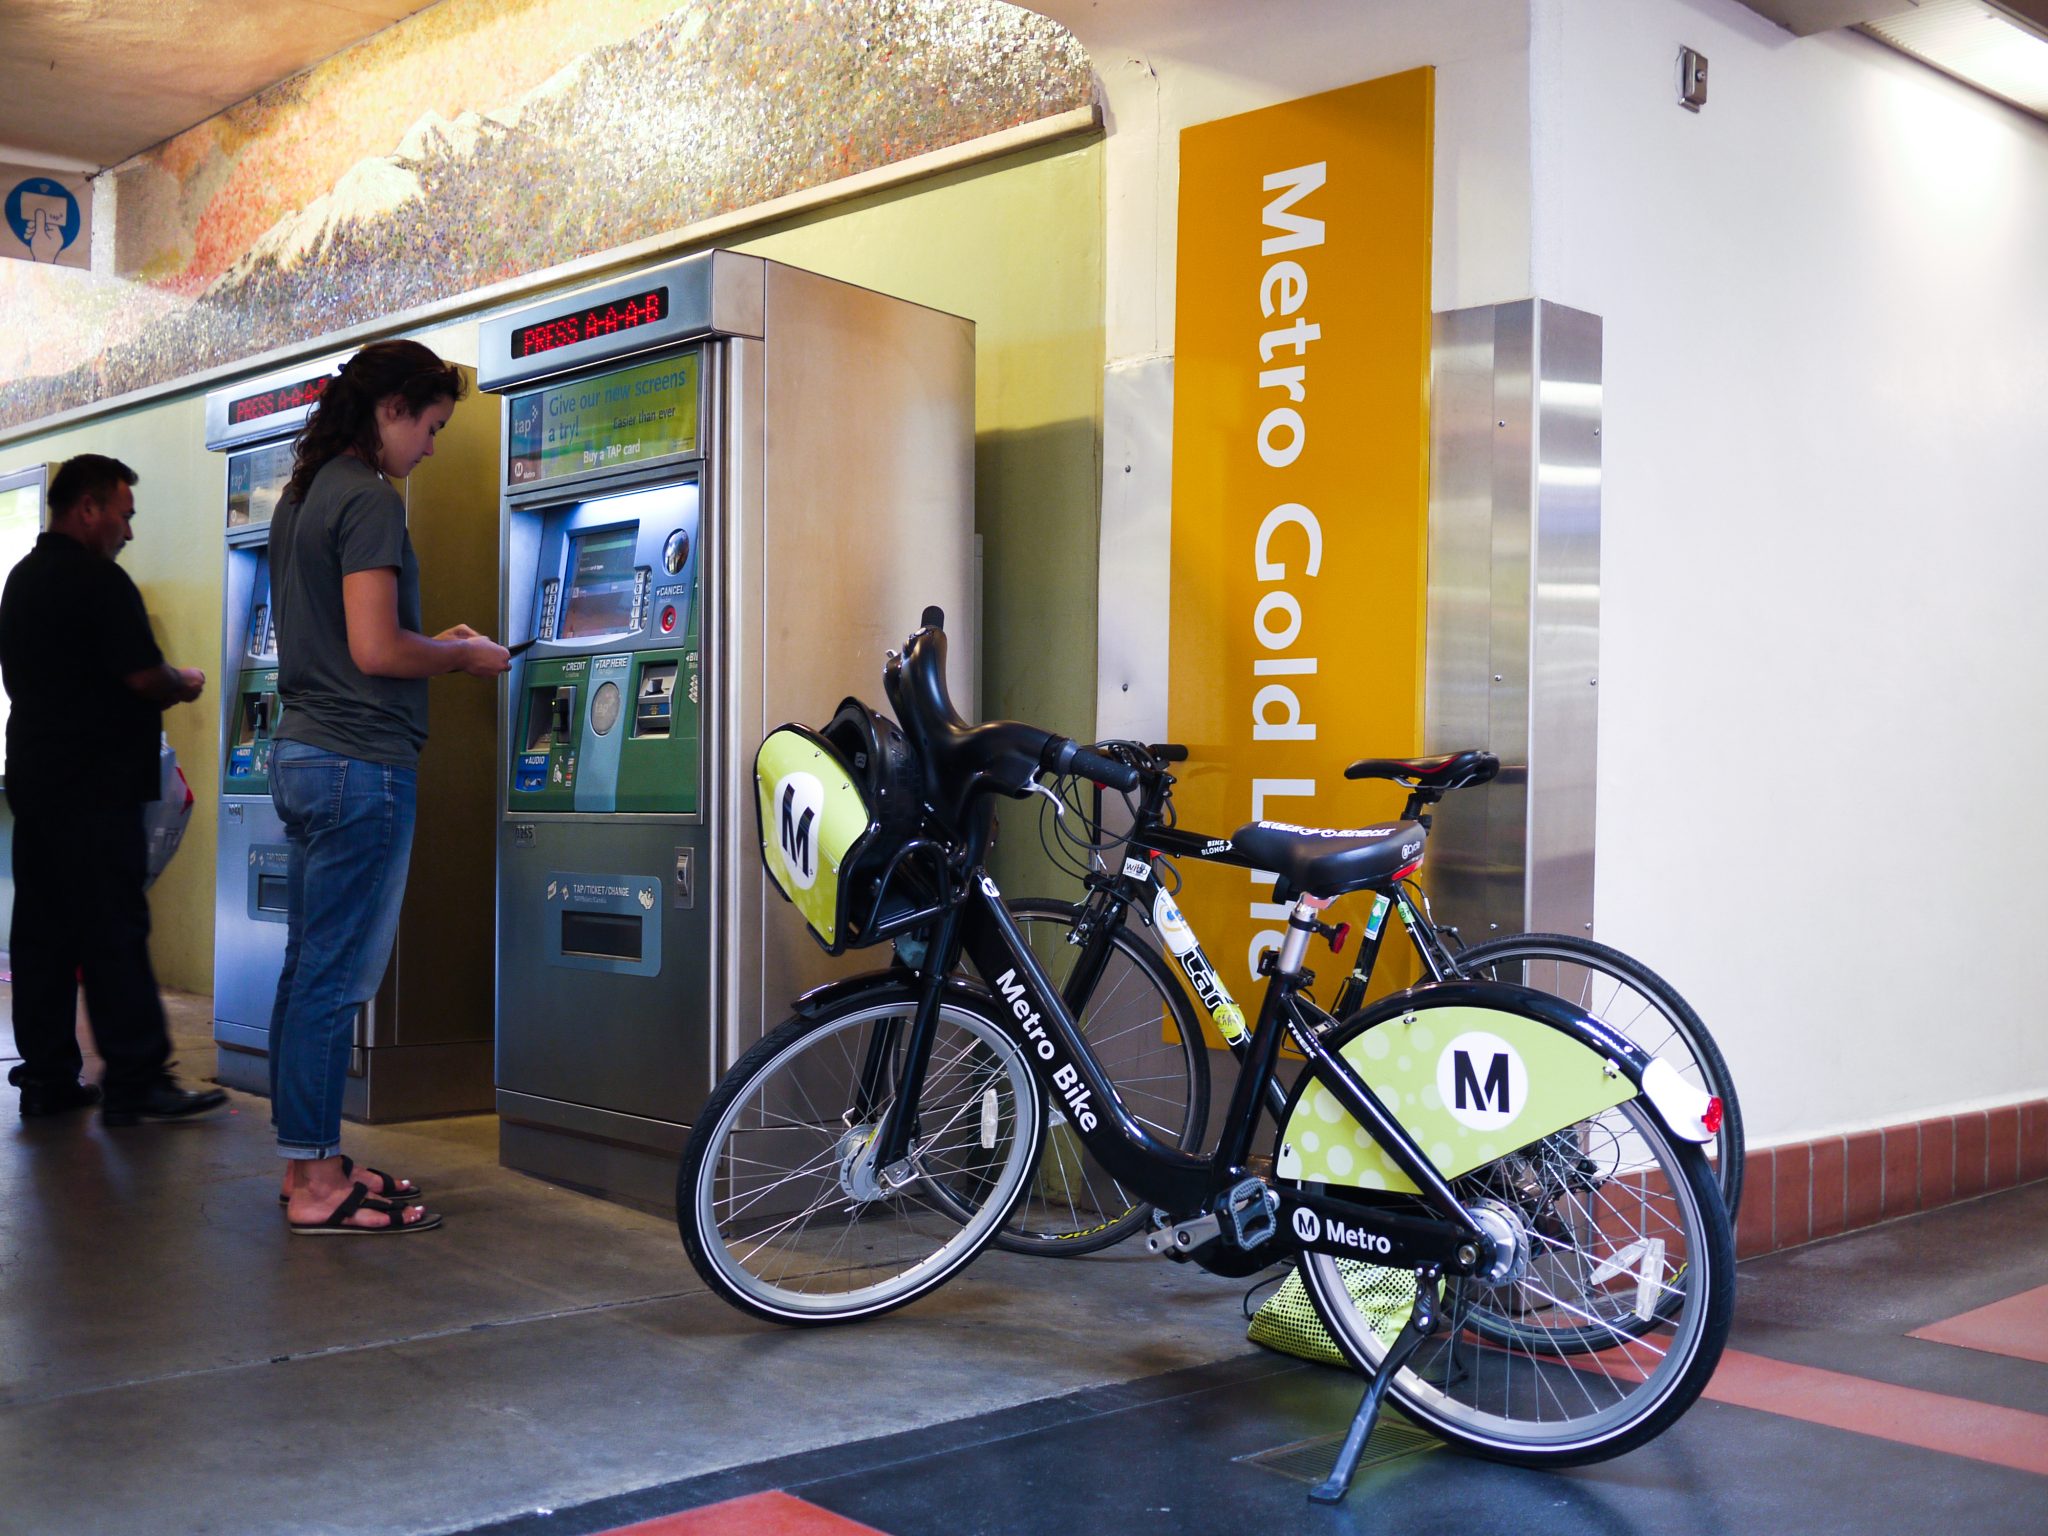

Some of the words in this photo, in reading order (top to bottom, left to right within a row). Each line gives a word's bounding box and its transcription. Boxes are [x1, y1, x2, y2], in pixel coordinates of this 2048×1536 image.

[1257, 161, 1326, 468] Metro
[524, 318, 578, 356] PRESS
[237, 393, 274, 423] PRESS
[549, 394, 576, 417] Give
[580, 391, 600, 409] our
[605, 383, 631, 401] new
[635, 369, 686, 397] screens
[514, 419, 531, 438] tap
[548, 428, 555, 442] a
[560, 416, 579, 448] try!
[613, 412, 637, 430] Easier
[639, 409, 657, 425] than
[659, 406, 676, 420] ever
[583, 450, 598, 466] Buy
[606, 444, 622, 460] TAP
[623, 439, 641, 456] card
[660, 585, 684, 596] CANCEL
[1252, 503, 1322, 740] Gold
[566, 661, 587, 671] CREDIT
[599, 659, 610, 669] TAP
[611, 657, 628, 668] HERE
[528, 756, 545, 765] AUDIO
[782, 783, 815, 878] M
[995, 968, 1055, 1060] Metro
[1052, 1062, 1099, 1135] Bike
[1288, 1019, 1317, 1060] TREK
[1453, 1050, 1511, 1114] M
[1326, 1219, 1391, 1254] Metro
